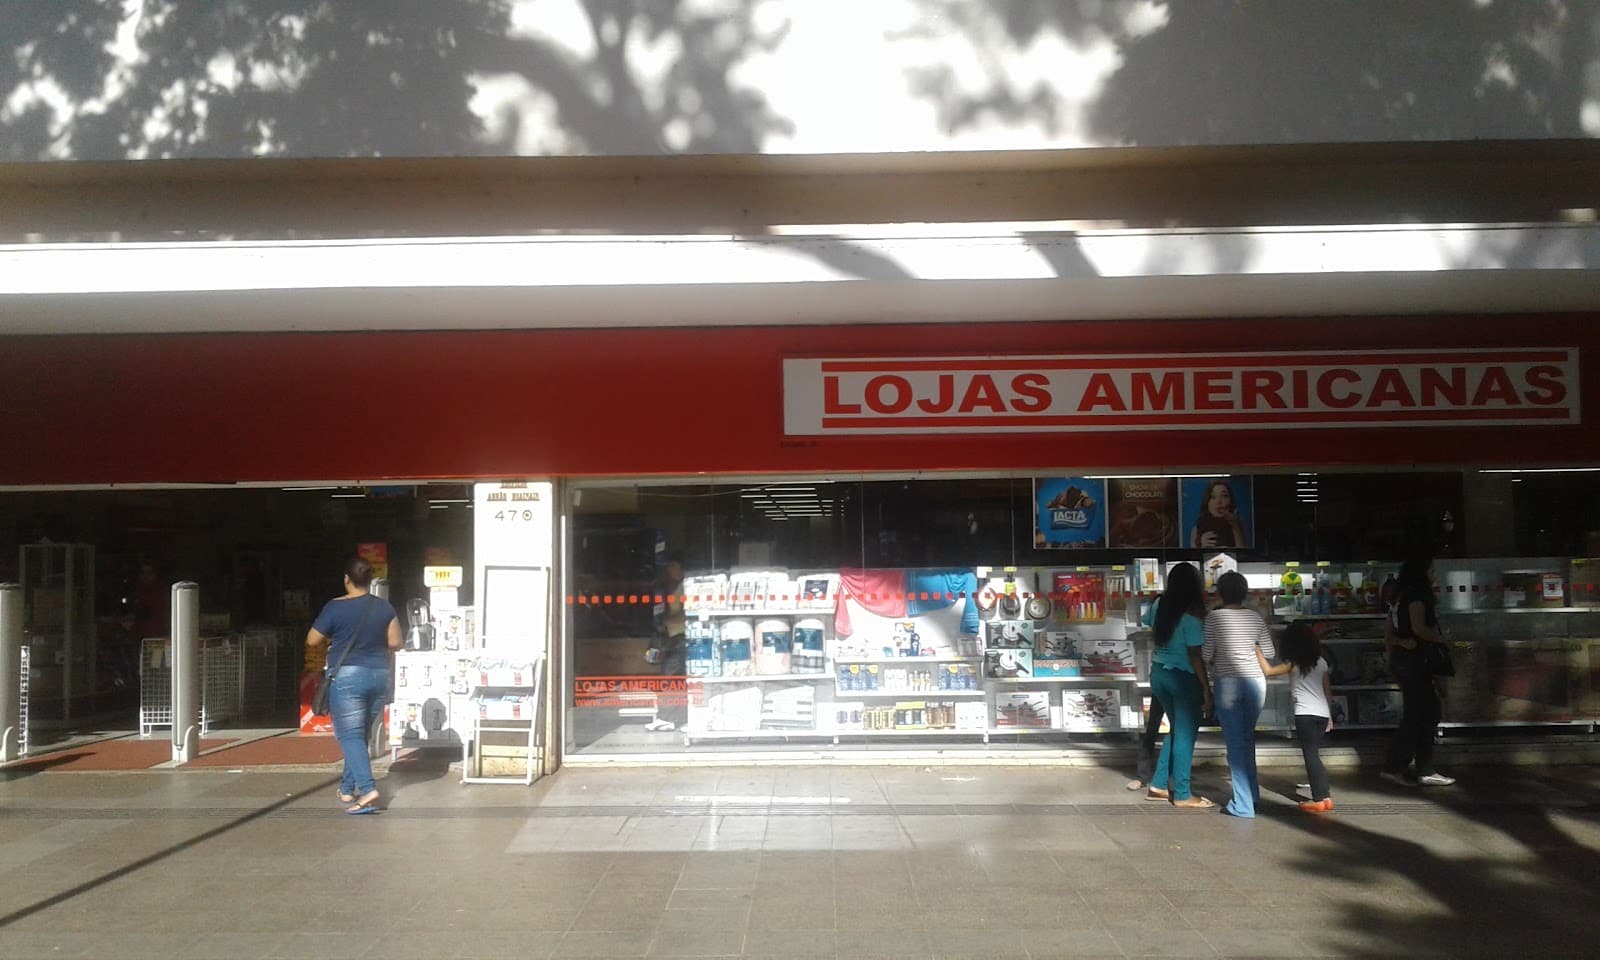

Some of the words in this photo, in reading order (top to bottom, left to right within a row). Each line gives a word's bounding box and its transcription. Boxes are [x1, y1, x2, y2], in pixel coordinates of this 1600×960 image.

[824, 374, 1053, 414] LOJAS
[1077, 366, 1568, 412] AMERICANAS
[495, 509, 533, 522] 470
[1053, 510, 1087, 523] LACTA
[575, 681, 616, 692] LOJAS
[620, 680, 704, 691] AMERICANAS
